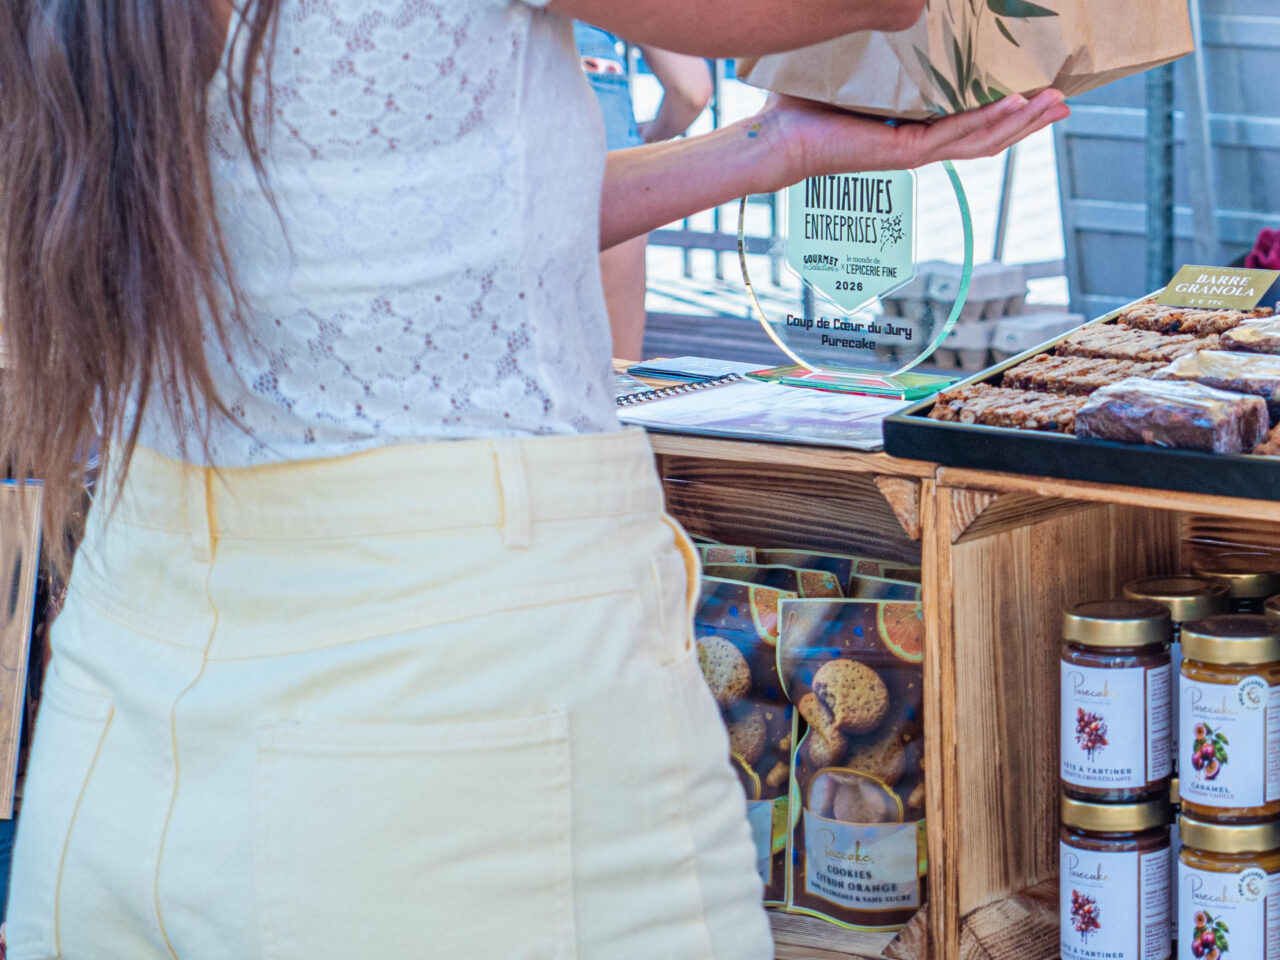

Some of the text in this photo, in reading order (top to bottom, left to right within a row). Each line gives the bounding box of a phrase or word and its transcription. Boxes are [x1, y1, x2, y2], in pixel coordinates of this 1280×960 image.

[805, 175, 893, 215] INITIATIVES
[804, 213, 878, 244] ENTREPRISES
[803, 254, 839, 266] GOURMET
[846, 254, 880, 265] le monde de
[881, 266, 898, 278] FINE
[835, 280, 863, 292] 2026
[1195, 274, 1252, 286] BARRE
[1175, 282, 1255, 297] GRANOLA
[786, 314, 912, 341] Coup de Cœur du Jury
[821, 334, 876, 350] Purecake
[1190, 781, 1231, 793] CARAMEL
[827, 864, 873, 880] COOKIES
[816, 871, 898, 893] CITRON ORANGE
